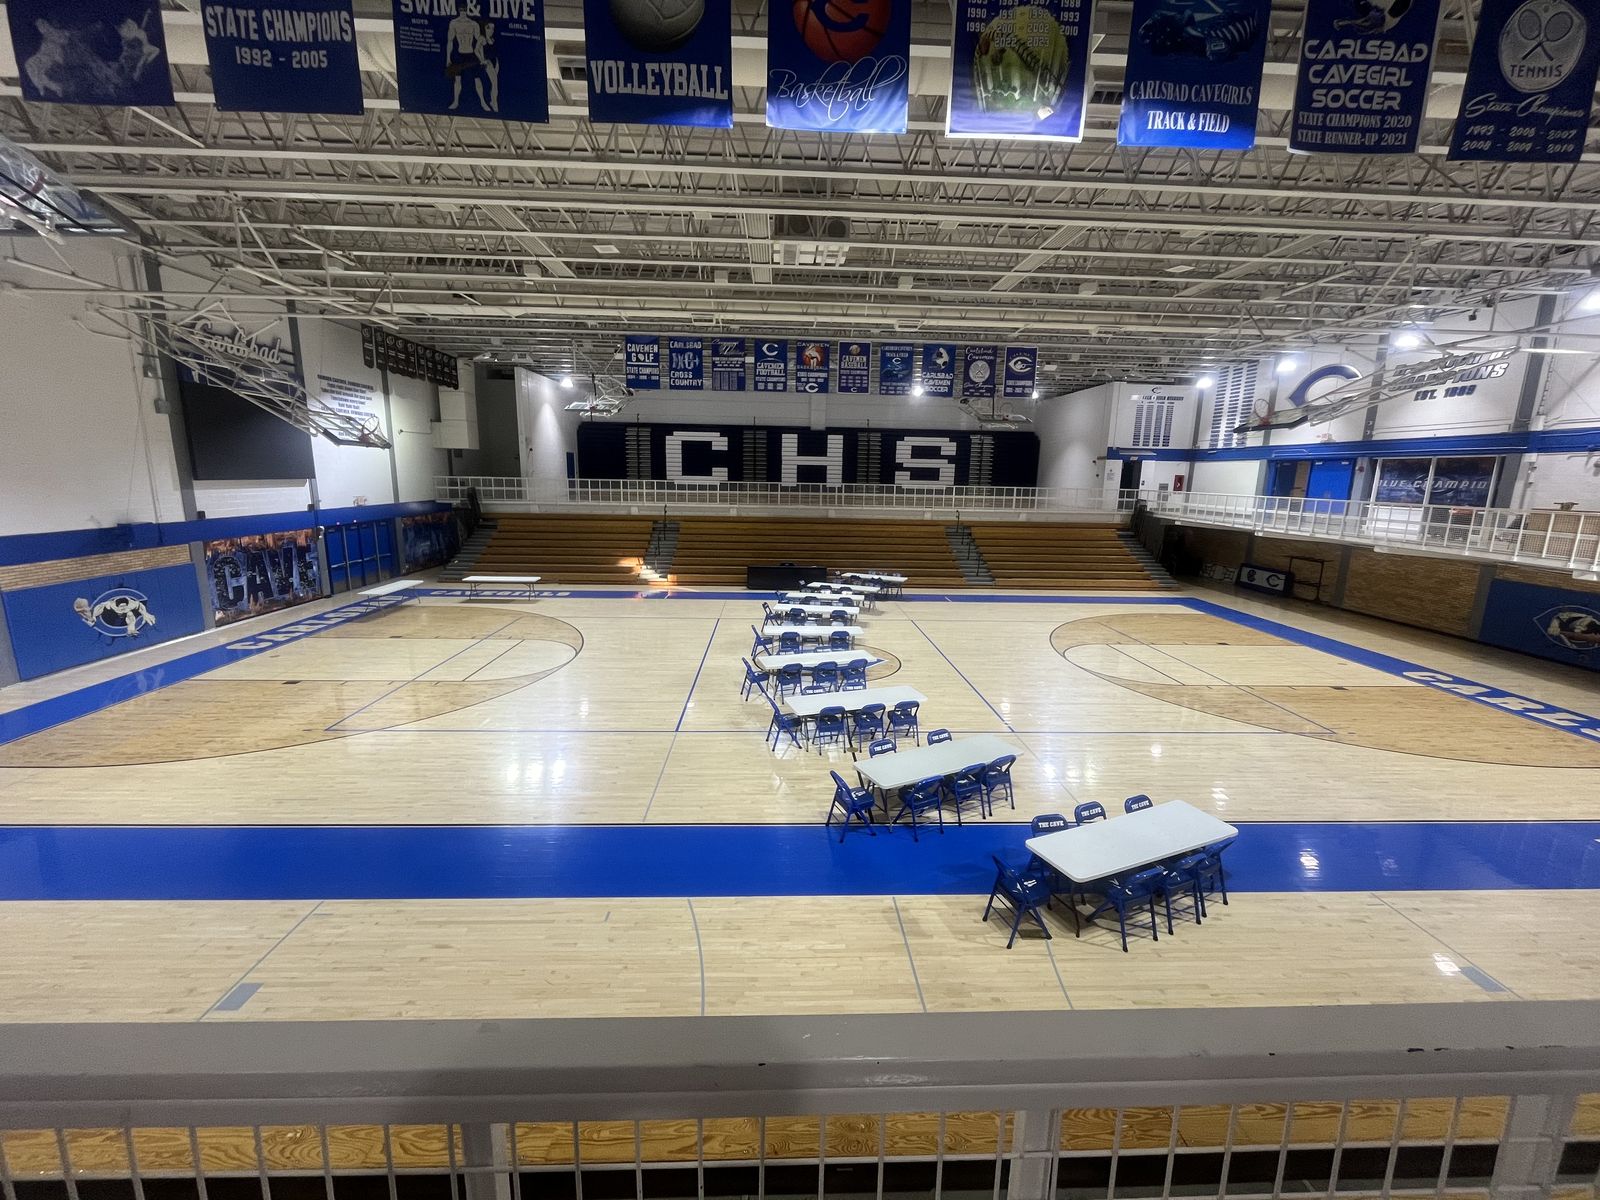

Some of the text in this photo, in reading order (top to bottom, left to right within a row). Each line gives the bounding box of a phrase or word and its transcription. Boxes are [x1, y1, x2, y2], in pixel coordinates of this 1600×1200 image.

[204, 5, 352, 43] STATE CHAMPIONS
[967, 7, 987, 18] 1990
[1060, 11, 1080, 23] 1993
[1060, 24, 1079, 36] 2010
[235, 45, 272, 68] 1992
[291, 49, 328, 69] 2005
[1303, 38, 1429, 63] CARLSBAD
[589, 59, 730, 101] VOLLEYBALL
[1307, 63, 1414, 88] CAVEGIRL
[1509, 64, 1564, 79] TENNIS
[769, 54, 908, 122] Basketball
[1129, 79, 1254, 106] CARLSBAD CAVEGIRLS
[1310, 88, 1402, 111] SOCCER
[1464, 92, 1513, 119] State
[1146, 109, 1231, 134] TRACK & FIELD
[1298, 110, 1413, 129] STATE CHAMPIONS 2020
[1296, 129, 1409, 146] STATE RUNNER-UP 2021
[627, 343, 659, 353] CAVEMEN
[670, 370, 693, 379] CROSS
[670, 378, 703, 387] COUNTRY
[921, 371, 954, 380] CARLSBAD
[1413, 479, 1488, 489] CAMPIO
[1089, 807, 1102, 815] CAVE
[1049, 820, 1065, 828] CAVE
